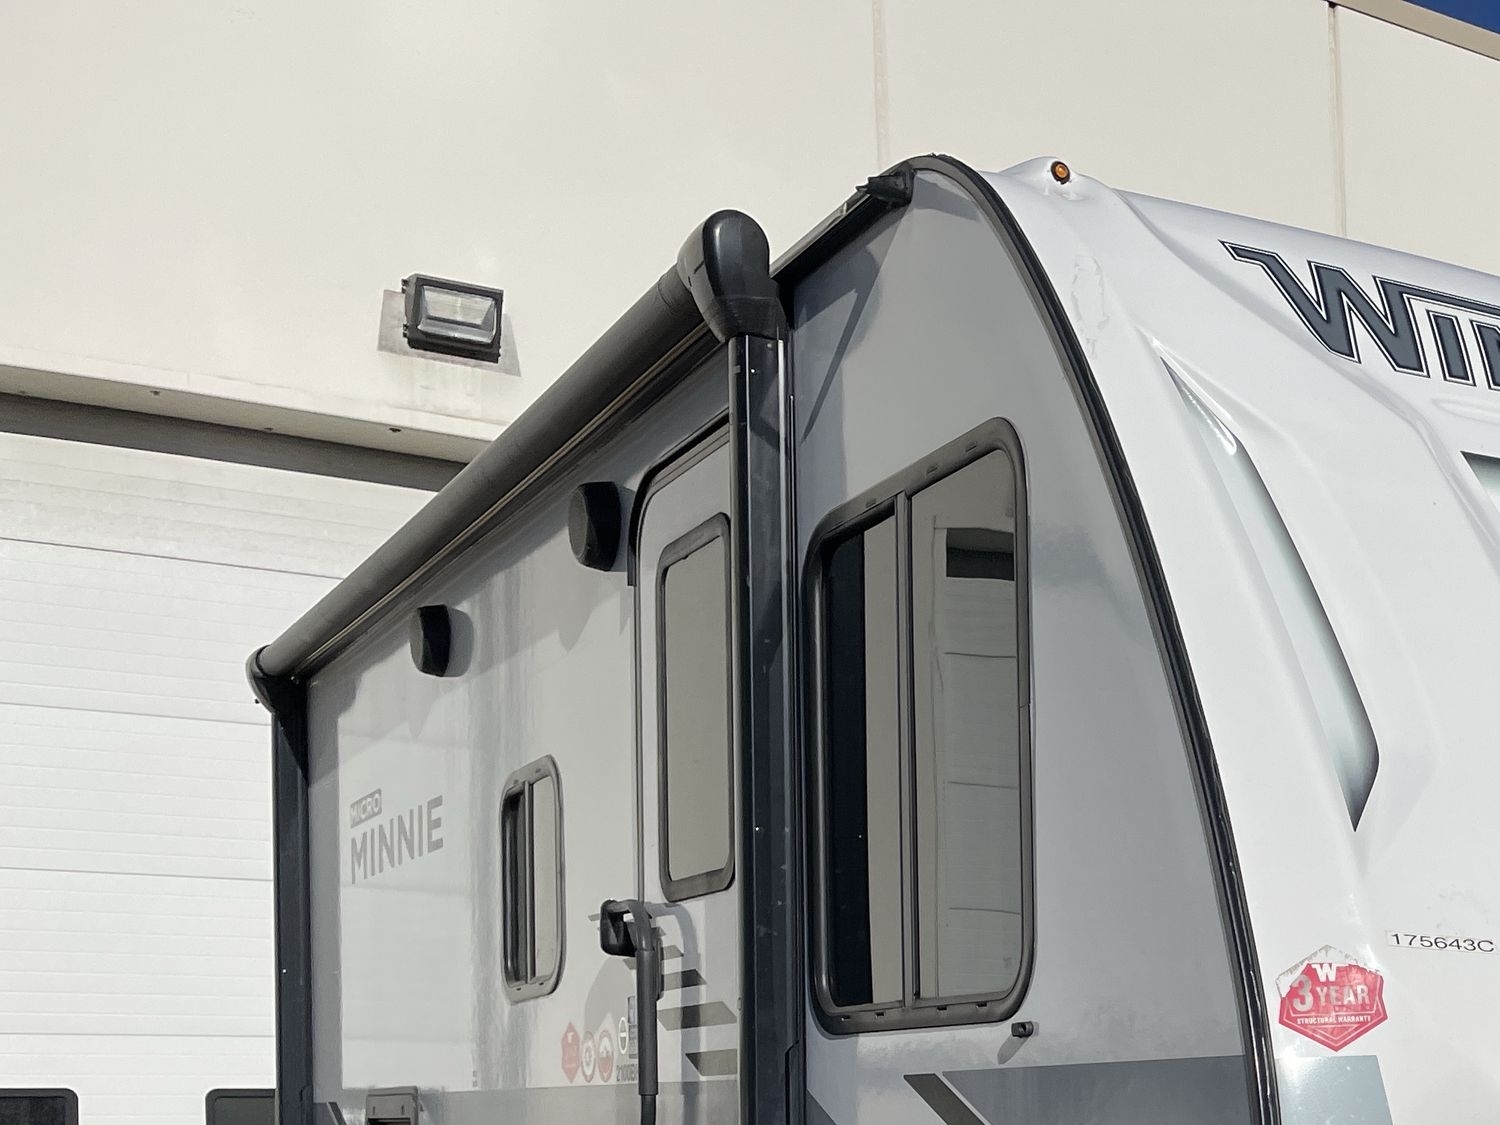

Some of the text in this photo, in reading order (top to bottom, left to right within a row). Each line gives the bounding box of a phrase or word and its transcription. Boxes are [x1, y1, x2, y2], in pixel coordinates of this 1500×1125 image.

[350, 795, 443, 885] MINNIE
[1391, 933, 1495, 953] 175643C
[1291, 974, 1370, 1012] 3 YEAR
[1338, 1015, 1371, 1023] WARRANTY
